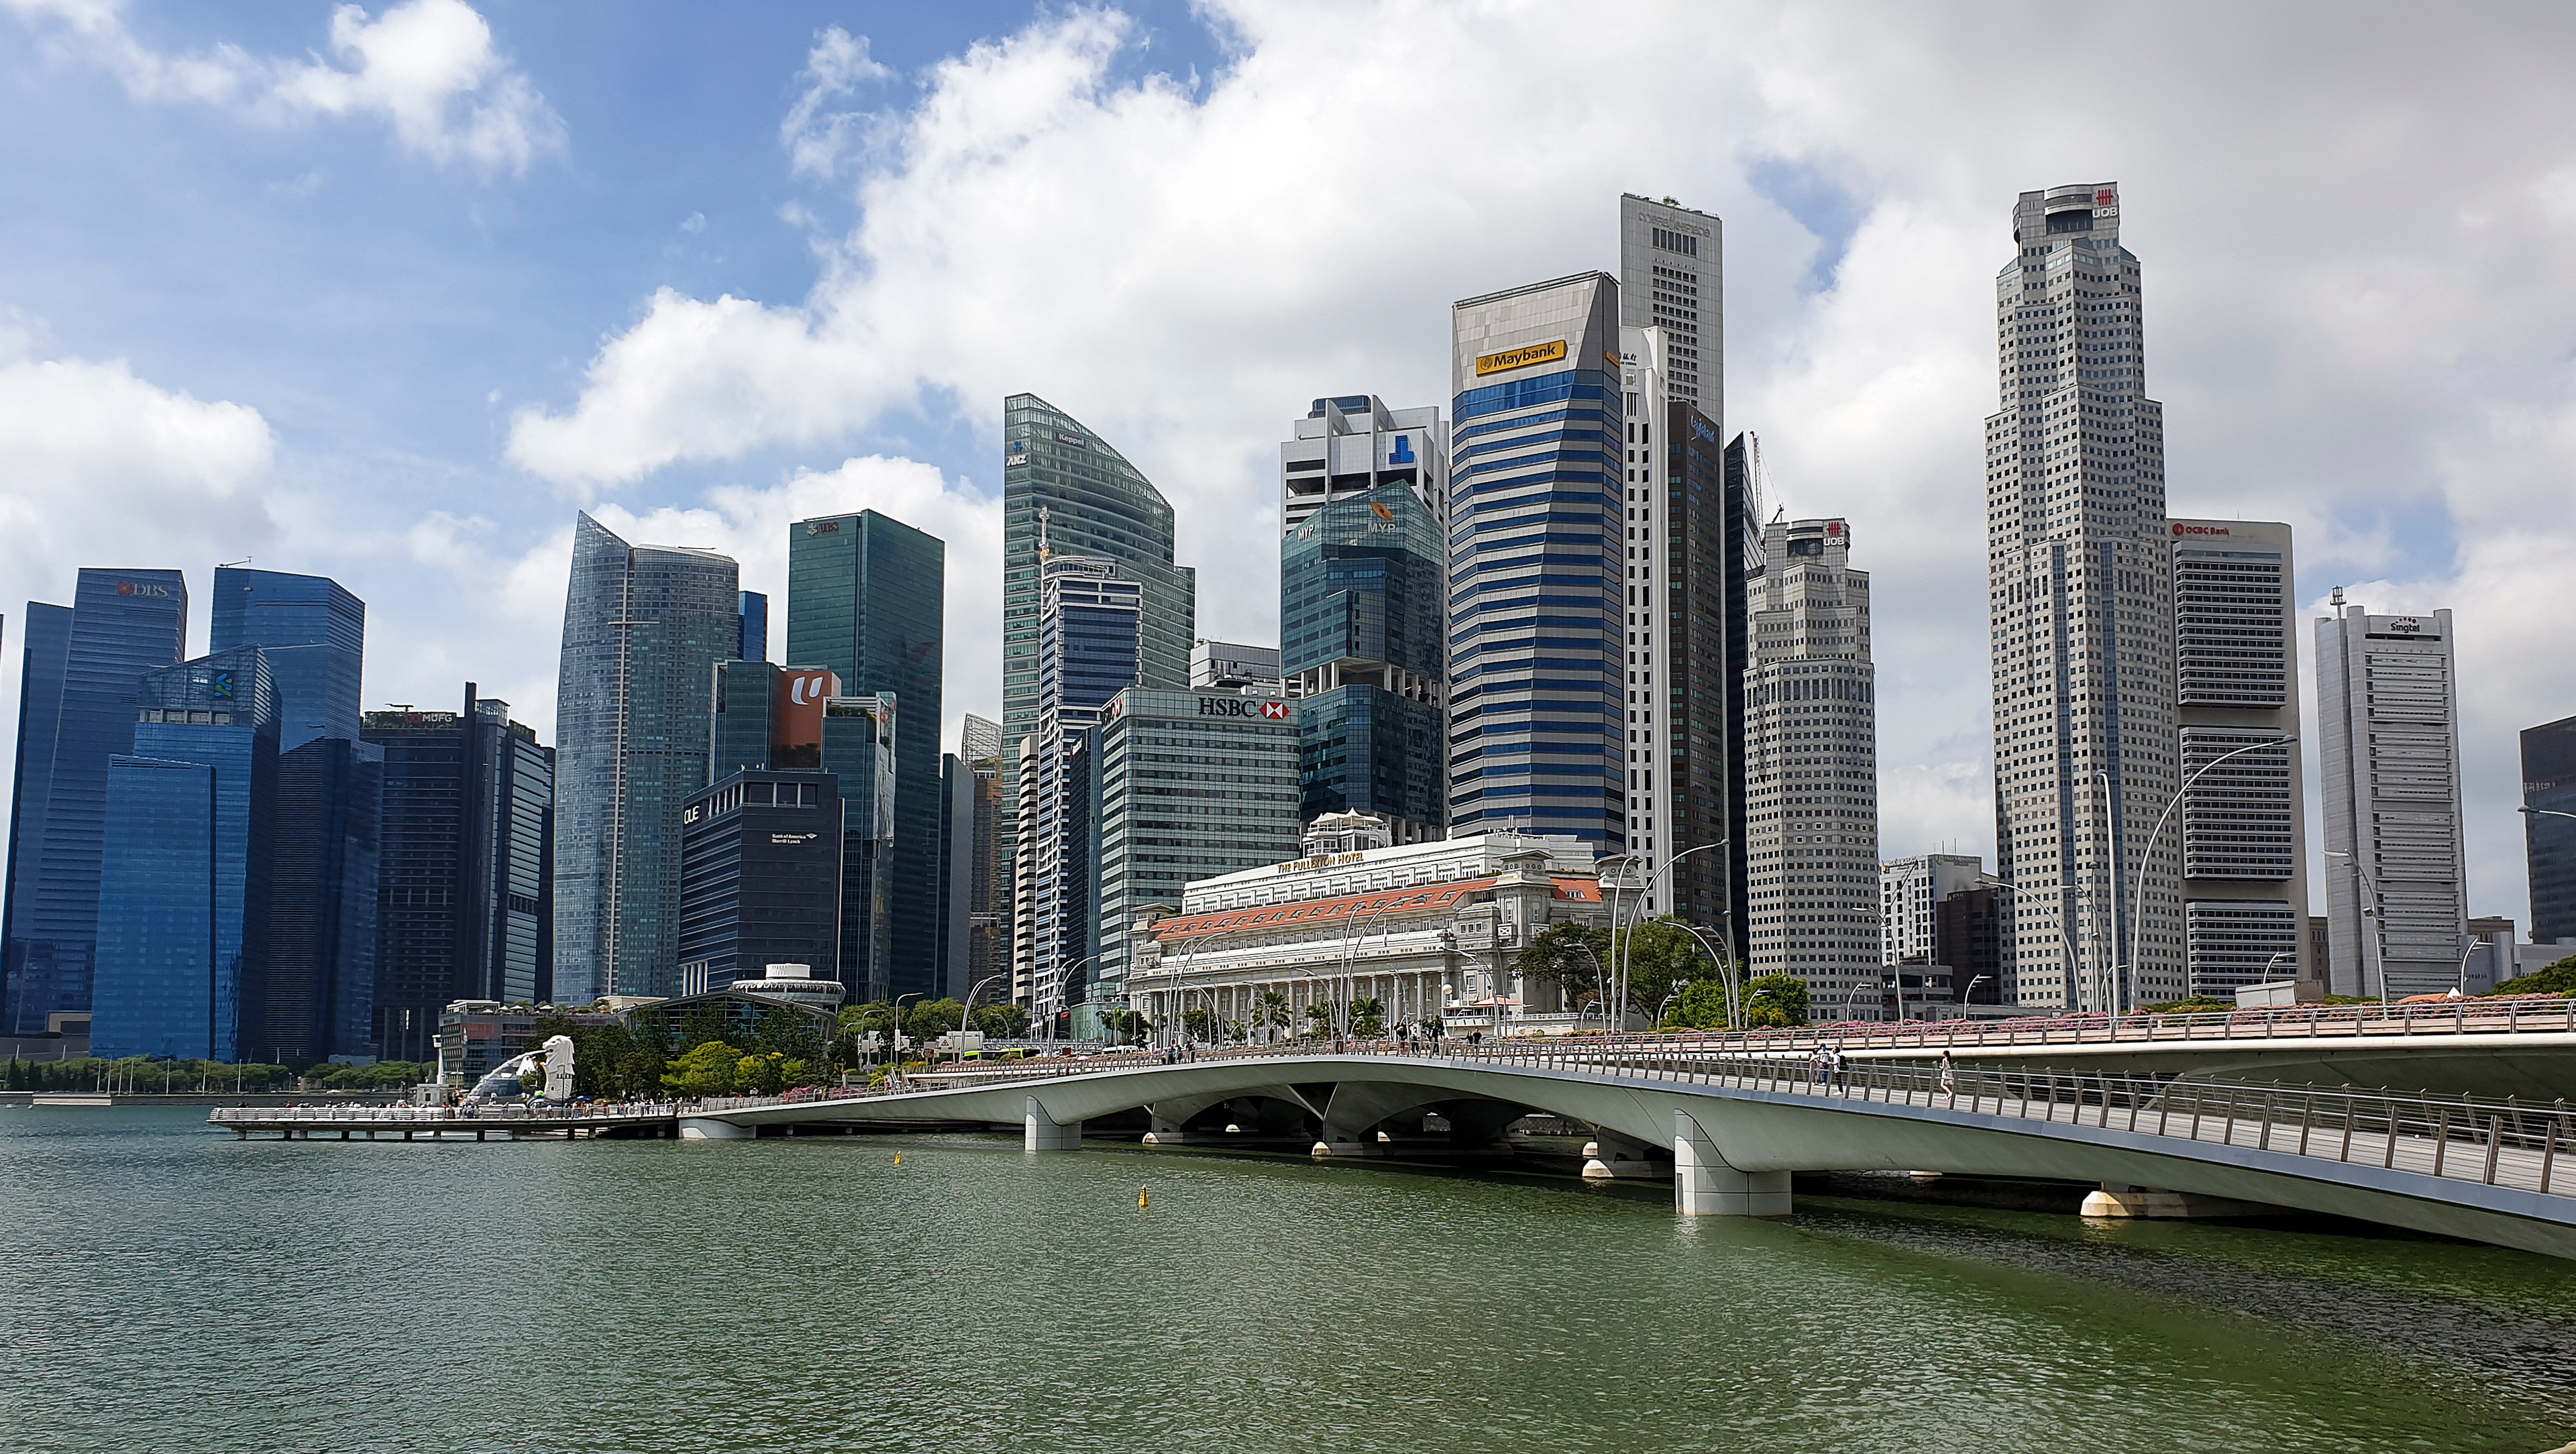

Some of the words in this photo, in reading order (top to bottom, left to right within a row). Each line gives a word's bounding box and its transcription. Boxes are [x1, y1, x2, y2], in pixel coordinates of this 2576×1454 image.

[2092, 207, 2118, 218] UOB
[1494, 345, 1555, 366] Maybank
[1059, 433, 1084, 446] Keppel
[1007, 455, 1027, 467] ANZ
[1298, 524, 1315, 542] MYP
[1368, 520, 1396, 534] MYP
[2186, 526, 2209, 534] OCBC
[2210, 526, 2230, 536] Bank
[1823, 537, 1845, 546] UOB
[132, 583, 168, 598] DBS
[2390, 621, 2420, 634] Singtel
[1199, 697, 1256, 717] HSBC
[422, 714, 453, 722] MUFG
[684, 805, 699, 824] OUE
[1277, 862, 1291, 873] THE
[1293, 856, 1335, 871] FULLERTON
[1338, 852, 1364, 864] HOTEL
